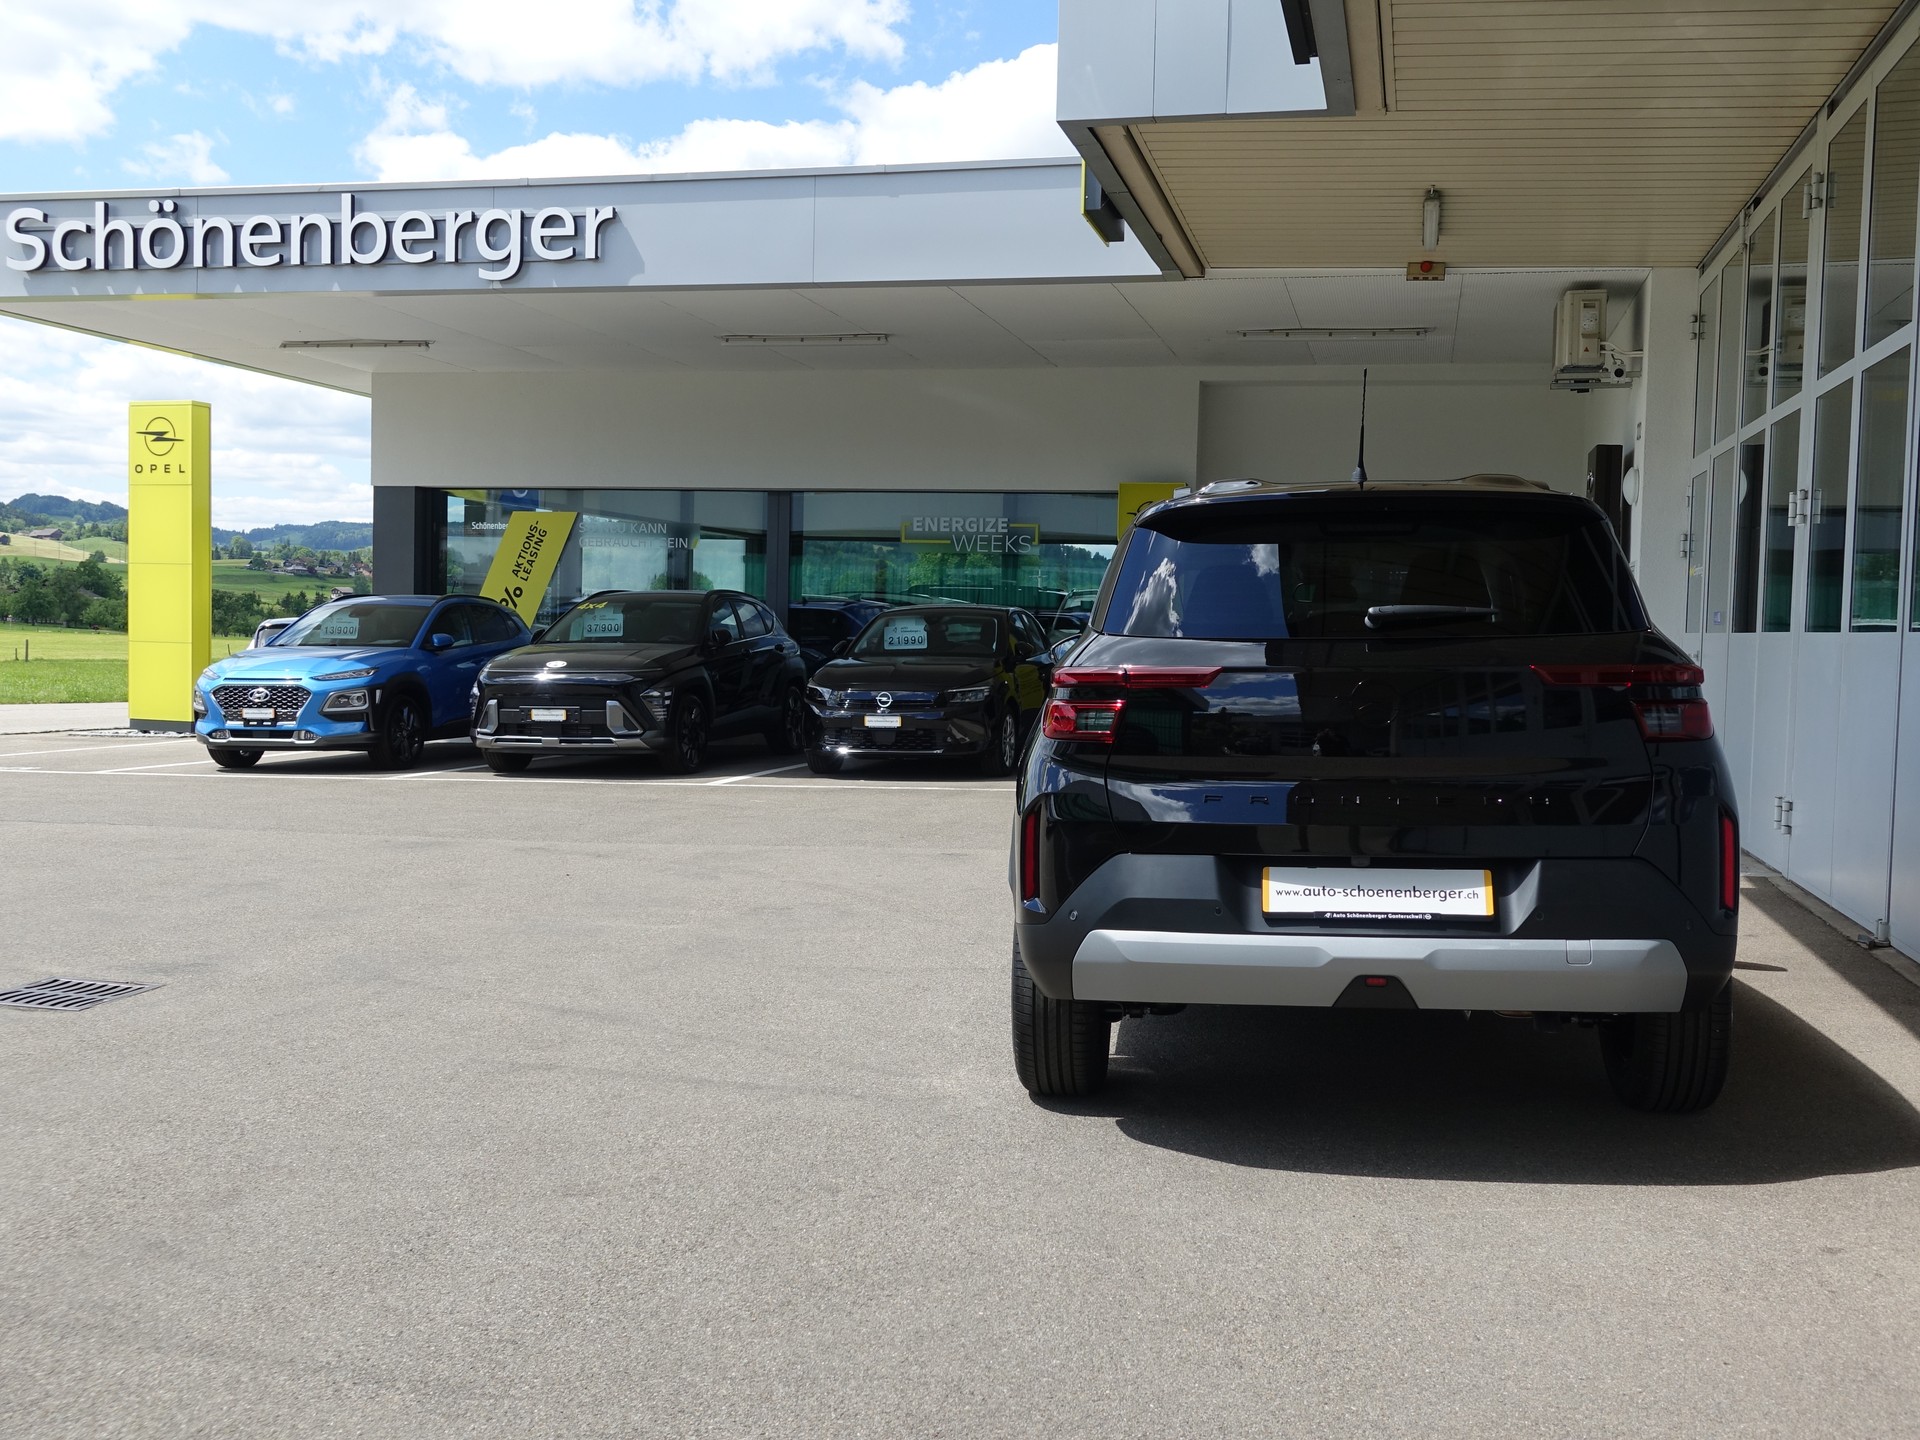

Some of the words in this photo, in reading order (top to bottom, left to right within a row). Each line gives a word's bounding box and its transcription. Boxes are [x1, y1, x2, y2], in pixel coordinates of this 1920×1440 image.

[5, 193, 617, 282] Schönenberger
[134, 463, 186, 474] OPEL
[630, 523, 667, 534] KANN
[912, 516, 1009, 533] ENERGIZE
[511, 520, 539, 578] AKTIONS-
[951, 534, 1032, 553] WEEKS
[519, 528, 548, 582] LEASING
[1275, 884, 1479, 902] www.auto-schoenenberger.ch
[1346, 912, 1387, 920] Schönenberger
